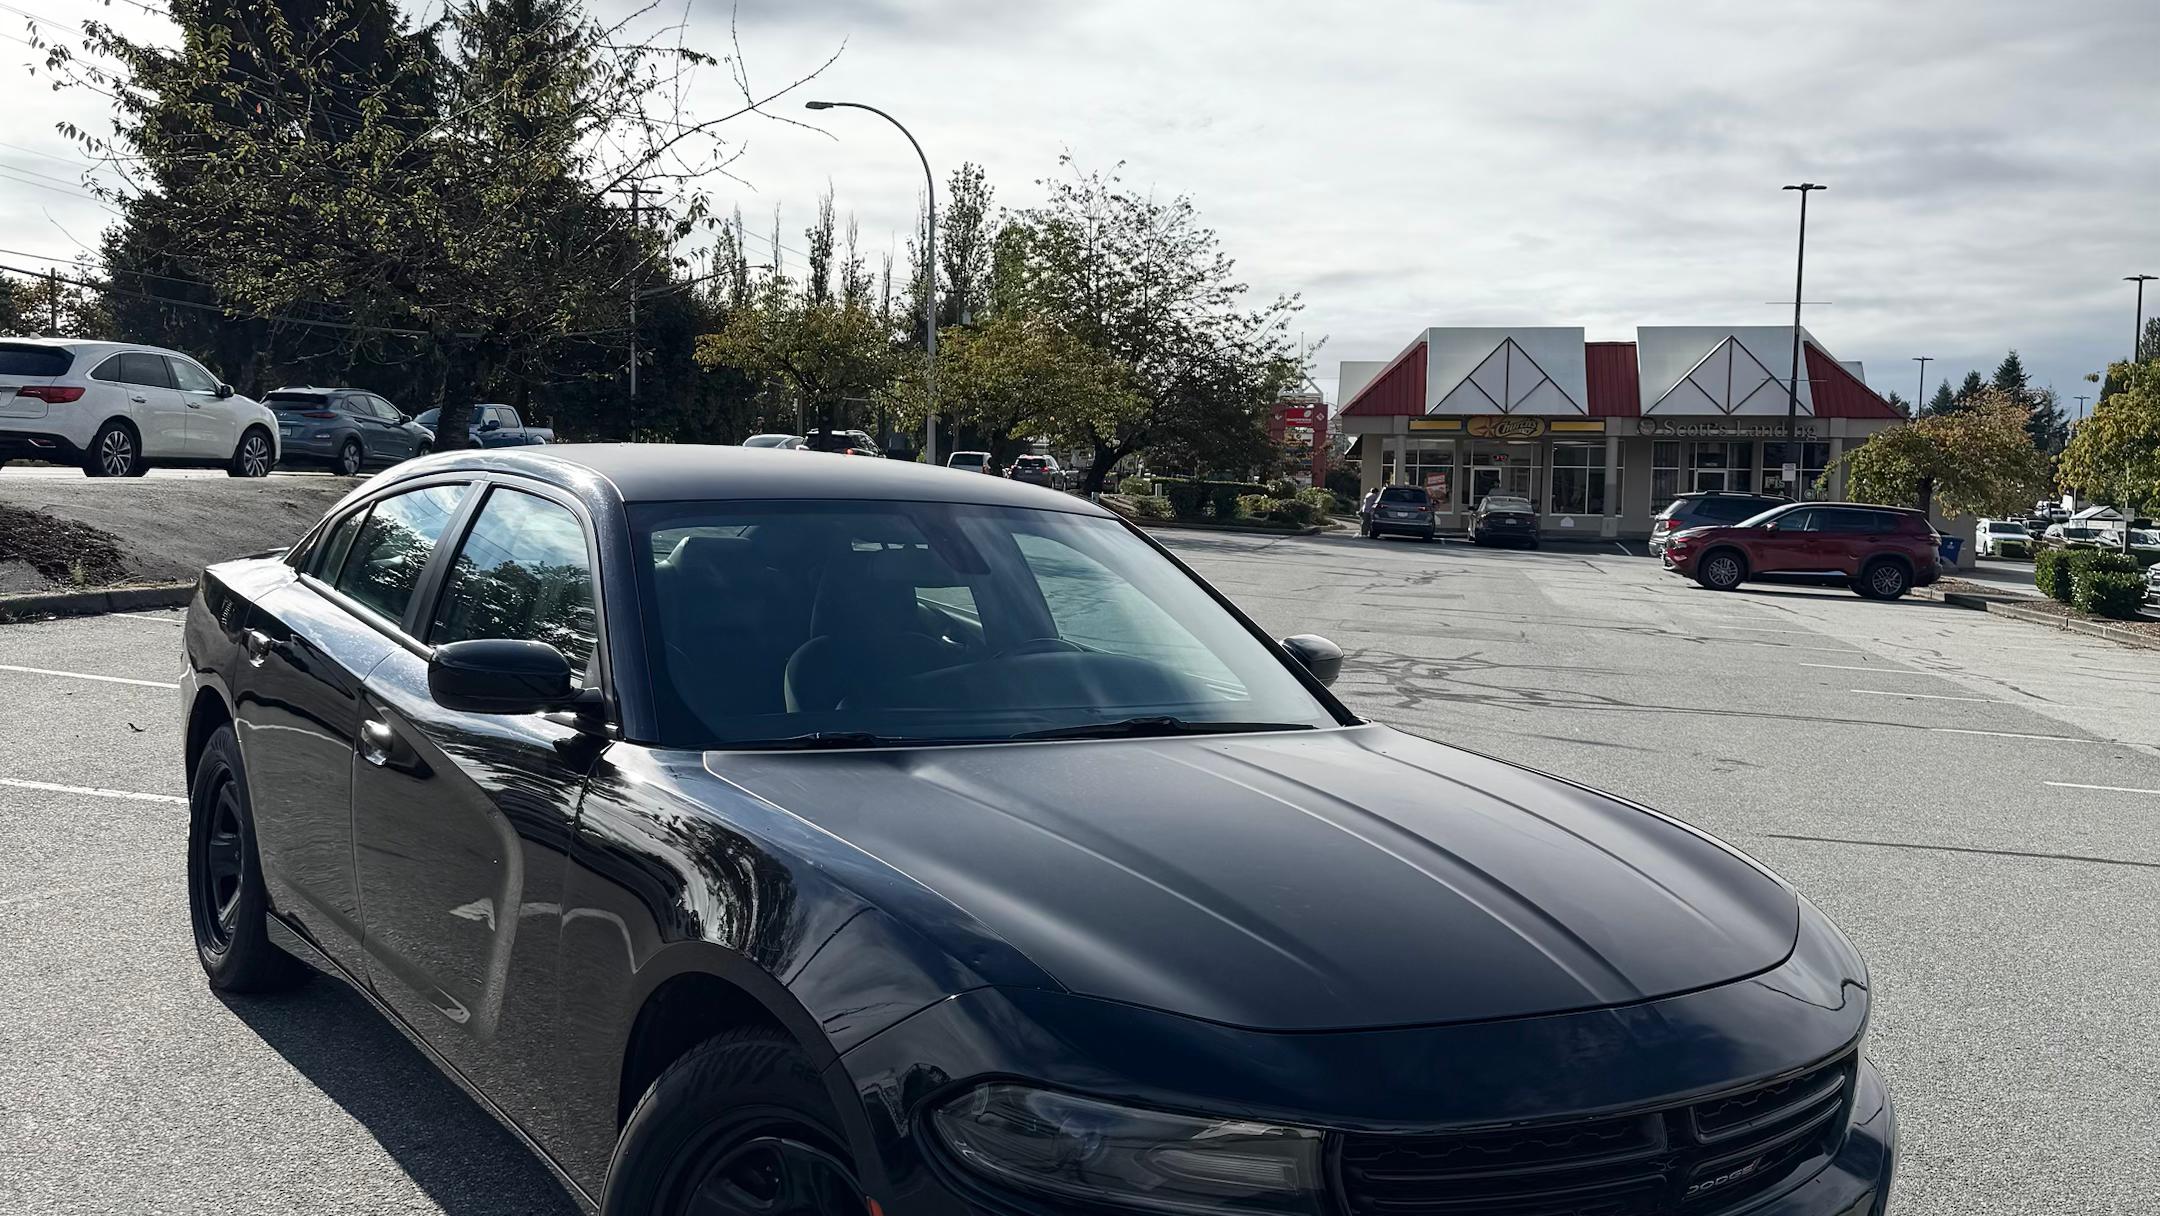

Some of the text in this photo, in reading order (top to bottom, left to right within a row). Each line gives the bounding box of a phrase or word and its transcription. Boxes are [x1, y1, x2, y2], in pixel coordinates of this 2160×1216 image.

[1664, 419, 1727, 437] Scott's
[1736, 419, 1817, 441] Landng
[1687, 1163, 1754, 1195] DODGE
